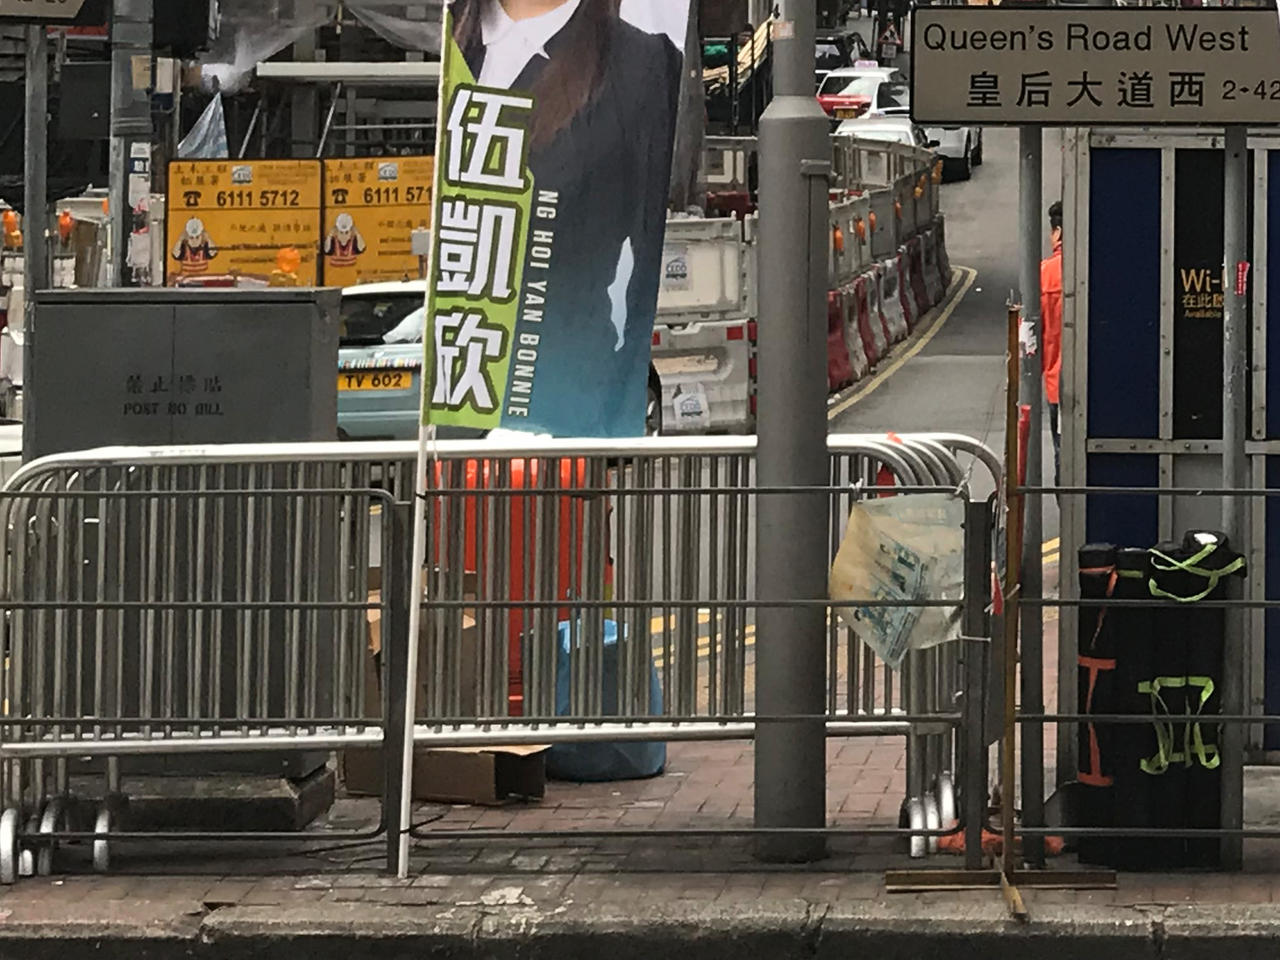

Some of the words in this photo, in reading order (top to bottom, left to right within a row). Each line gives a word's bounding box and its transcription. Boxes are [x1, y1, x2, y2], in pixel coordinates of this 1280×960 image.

[924, 23, 1054, 51] Queen's
[1066, 24, 1152, 51] Road
[1165, 24, 1250, 51] West
[966, 71, 1206, 109] 皇后大道西
[216, 190, 253, 207] 6111
[259, 189, 300, 207] 5712
[363, 186, 399, 203] 6111
[405, 185, 432, 202] 571
[536, 189, 559, 219] NG
[431, 88, 534, 410] 伍凱欣
[530, 230, 554, 268] HOI
[1180, 268, 1224, 292] Wi-
[523, 281, 548, 322] YAN
[345, 375, 365, 388] TV
[371, 374, 403, 388] 602
[508, 332, 540, 418] BONNIE
[123, 402, 160, 416] POST
[167, 401, 187, 416] NO
